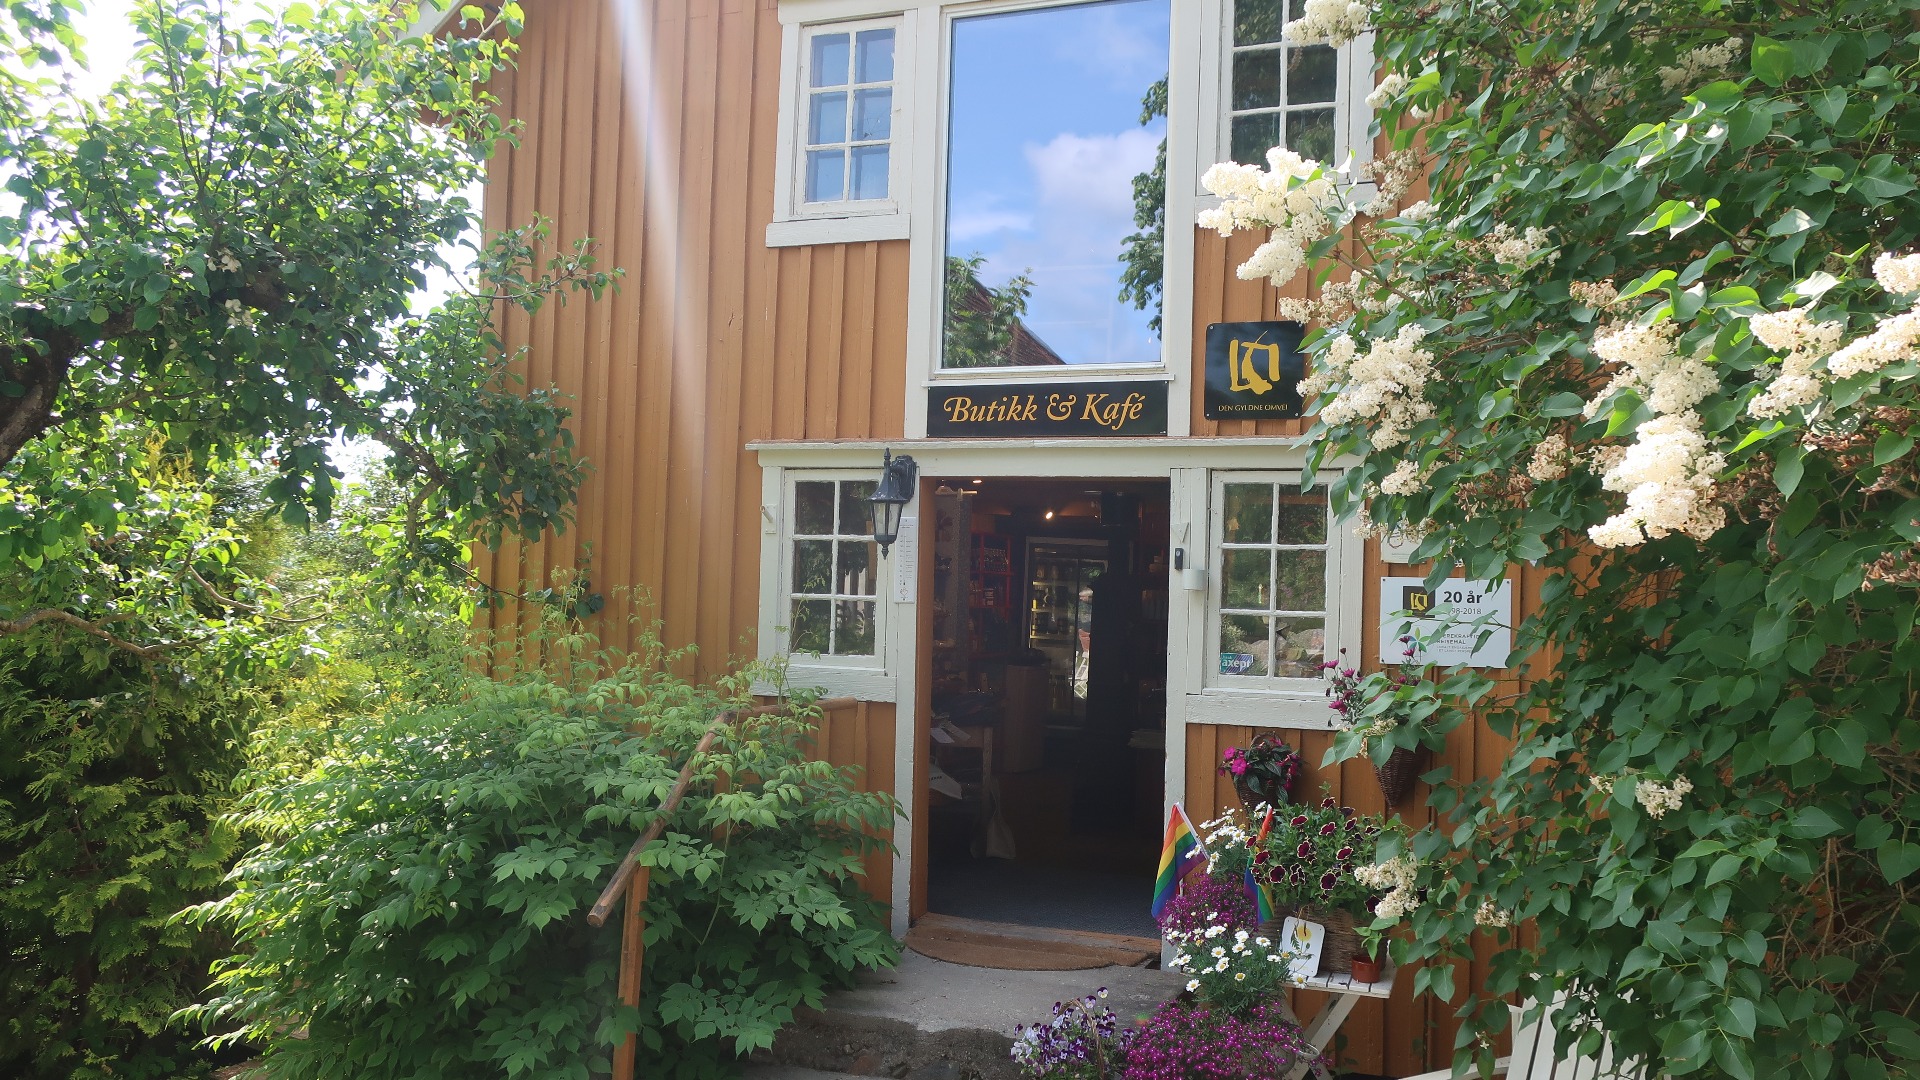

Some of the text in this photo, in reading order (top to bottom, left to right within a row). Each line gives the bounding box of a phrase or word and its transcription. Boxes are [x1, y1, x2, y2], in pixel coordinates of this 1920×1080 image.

[943, 392, 1146, 430] Butikk & Kafé
[1218, 404, 1234, 412] DEN
[1264, 403, 1288, 411] OMVEI
[1443, 590, 1483, 604] 20 år
[1451, 607, 1482, 615] 98-2018
[1221, 659, 1251, 671] axept
